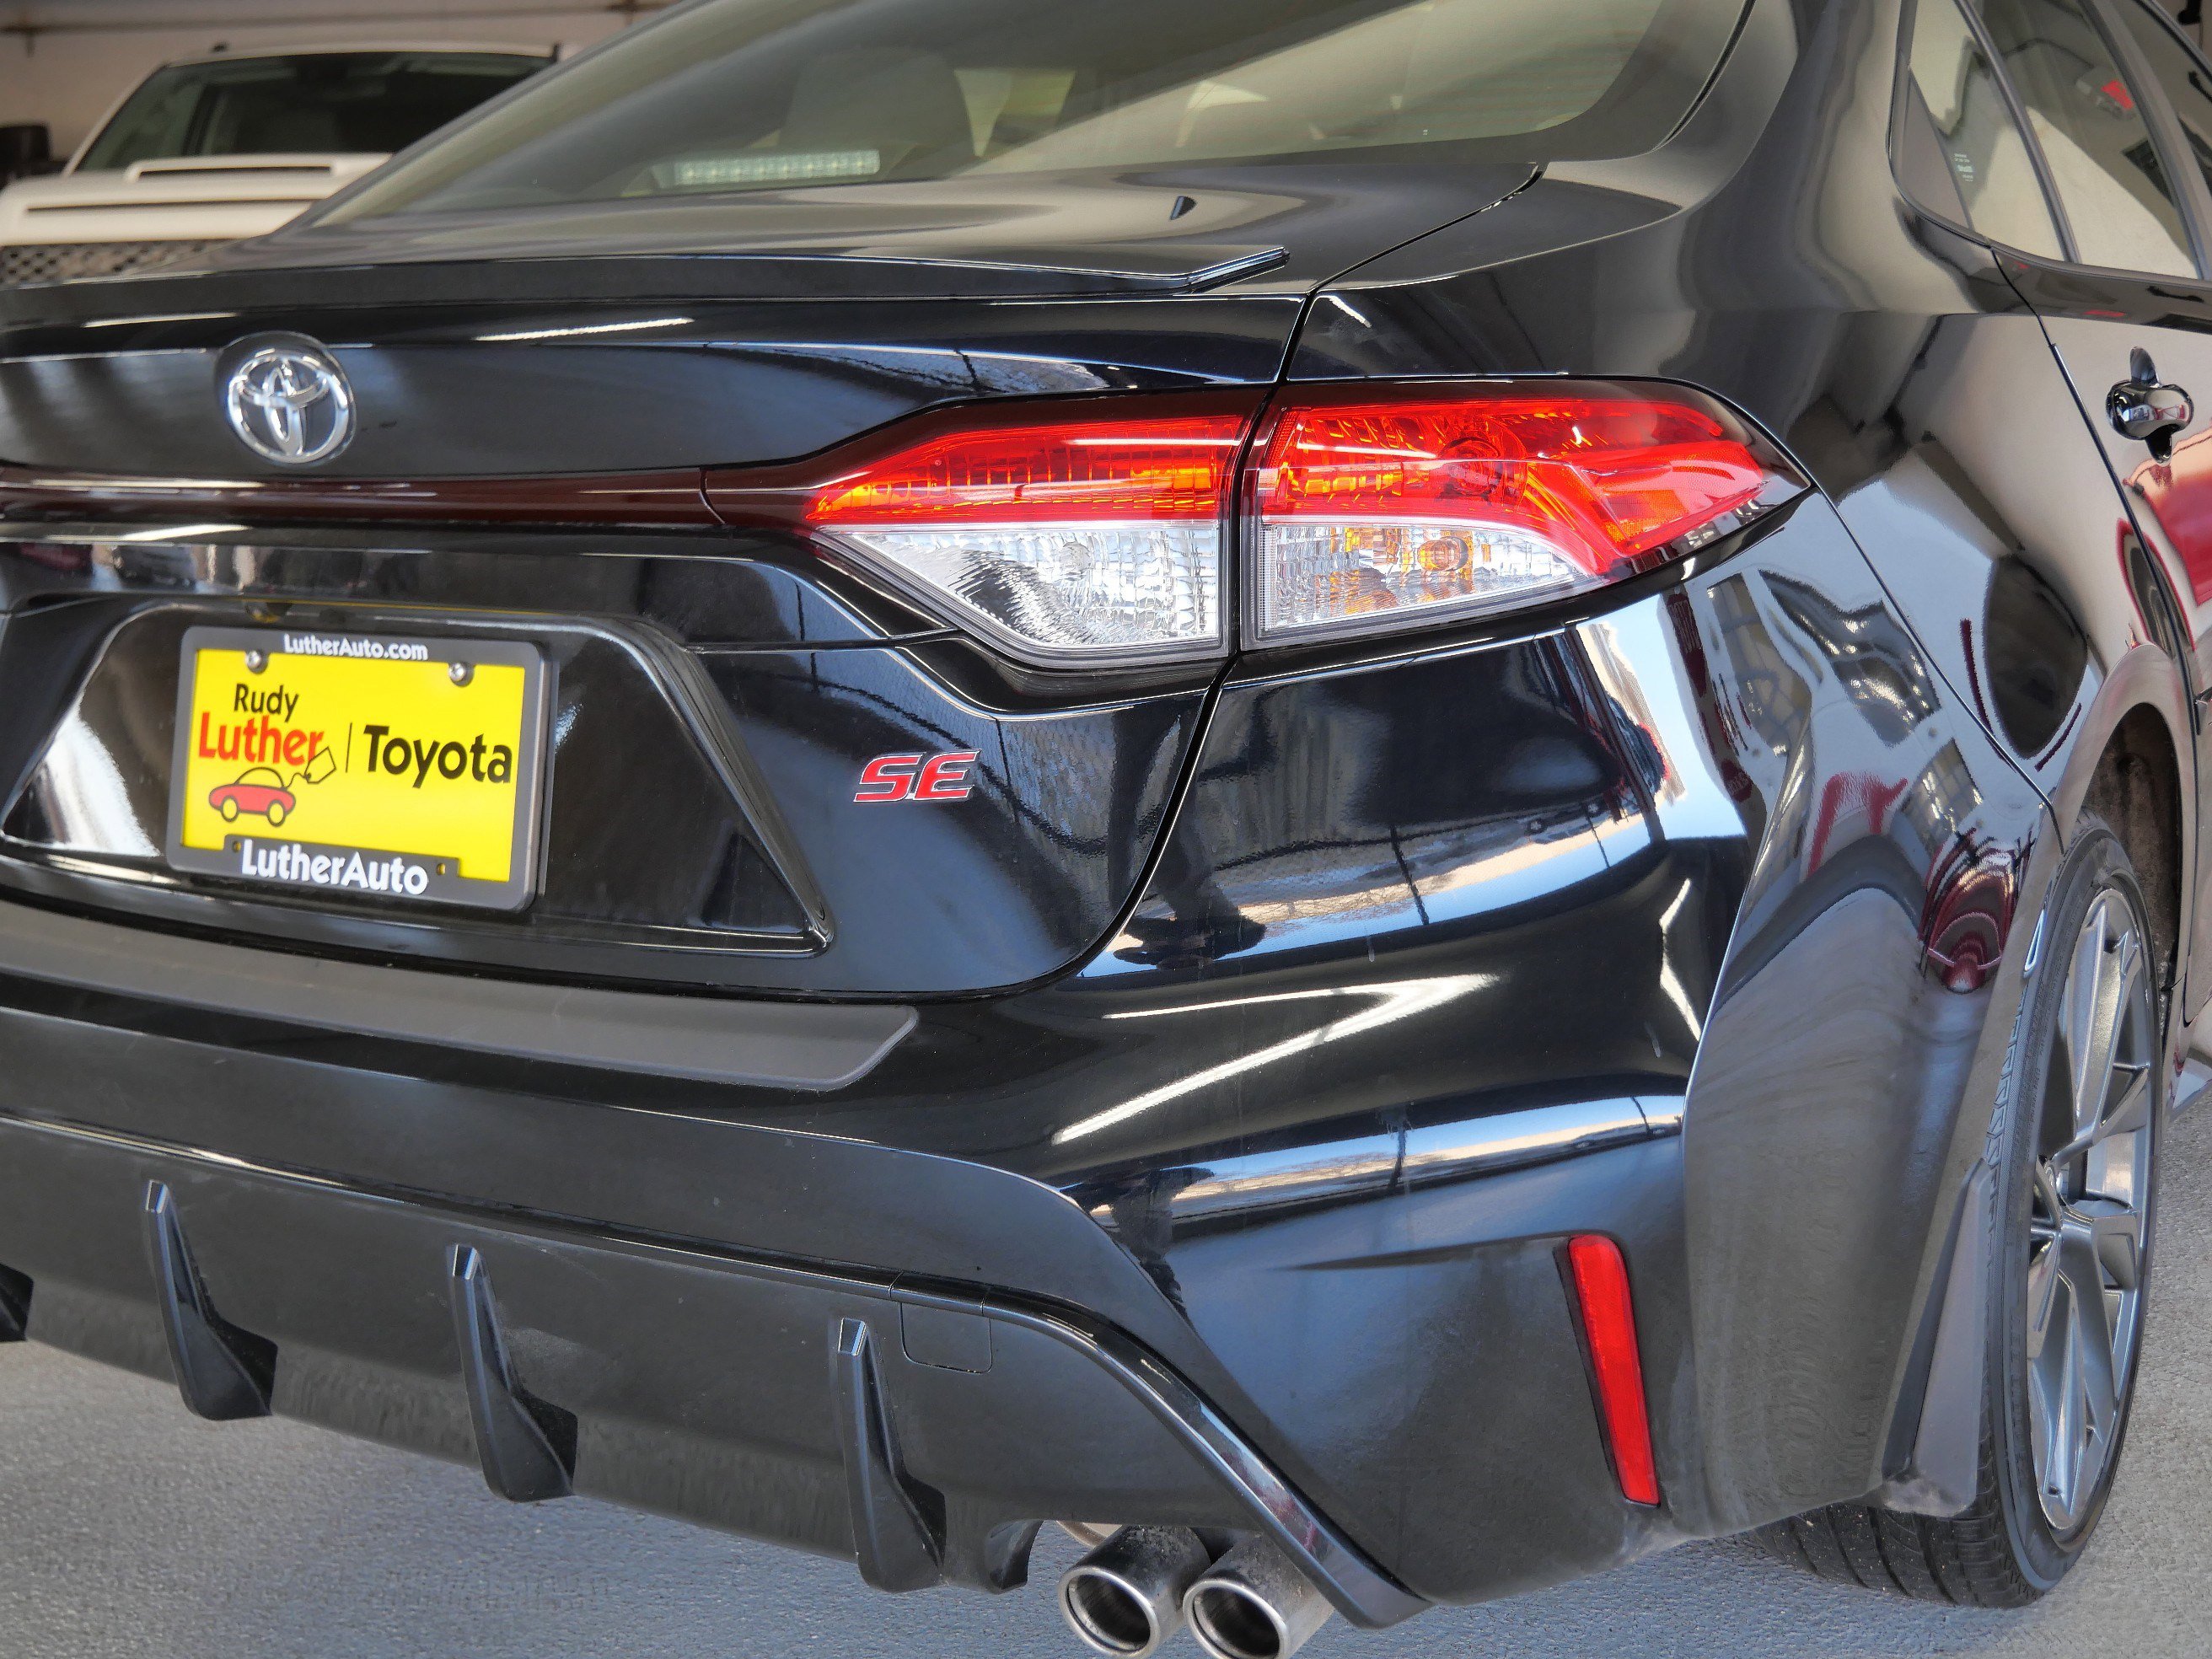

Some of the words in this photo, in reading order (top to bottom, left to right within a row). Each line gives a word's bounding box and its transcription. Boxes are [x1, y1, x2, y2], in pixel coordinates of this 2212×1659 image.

[283, 634, 428, 660] LutherAuto.com
[234, 683, 298, 722] Rudy
[199, 711, 325, 765] Luther
[363, 724, 513, 789] Toyota
[853, 749, 982, 803] SE
[241, 839, 428, 895] LutherAuto
